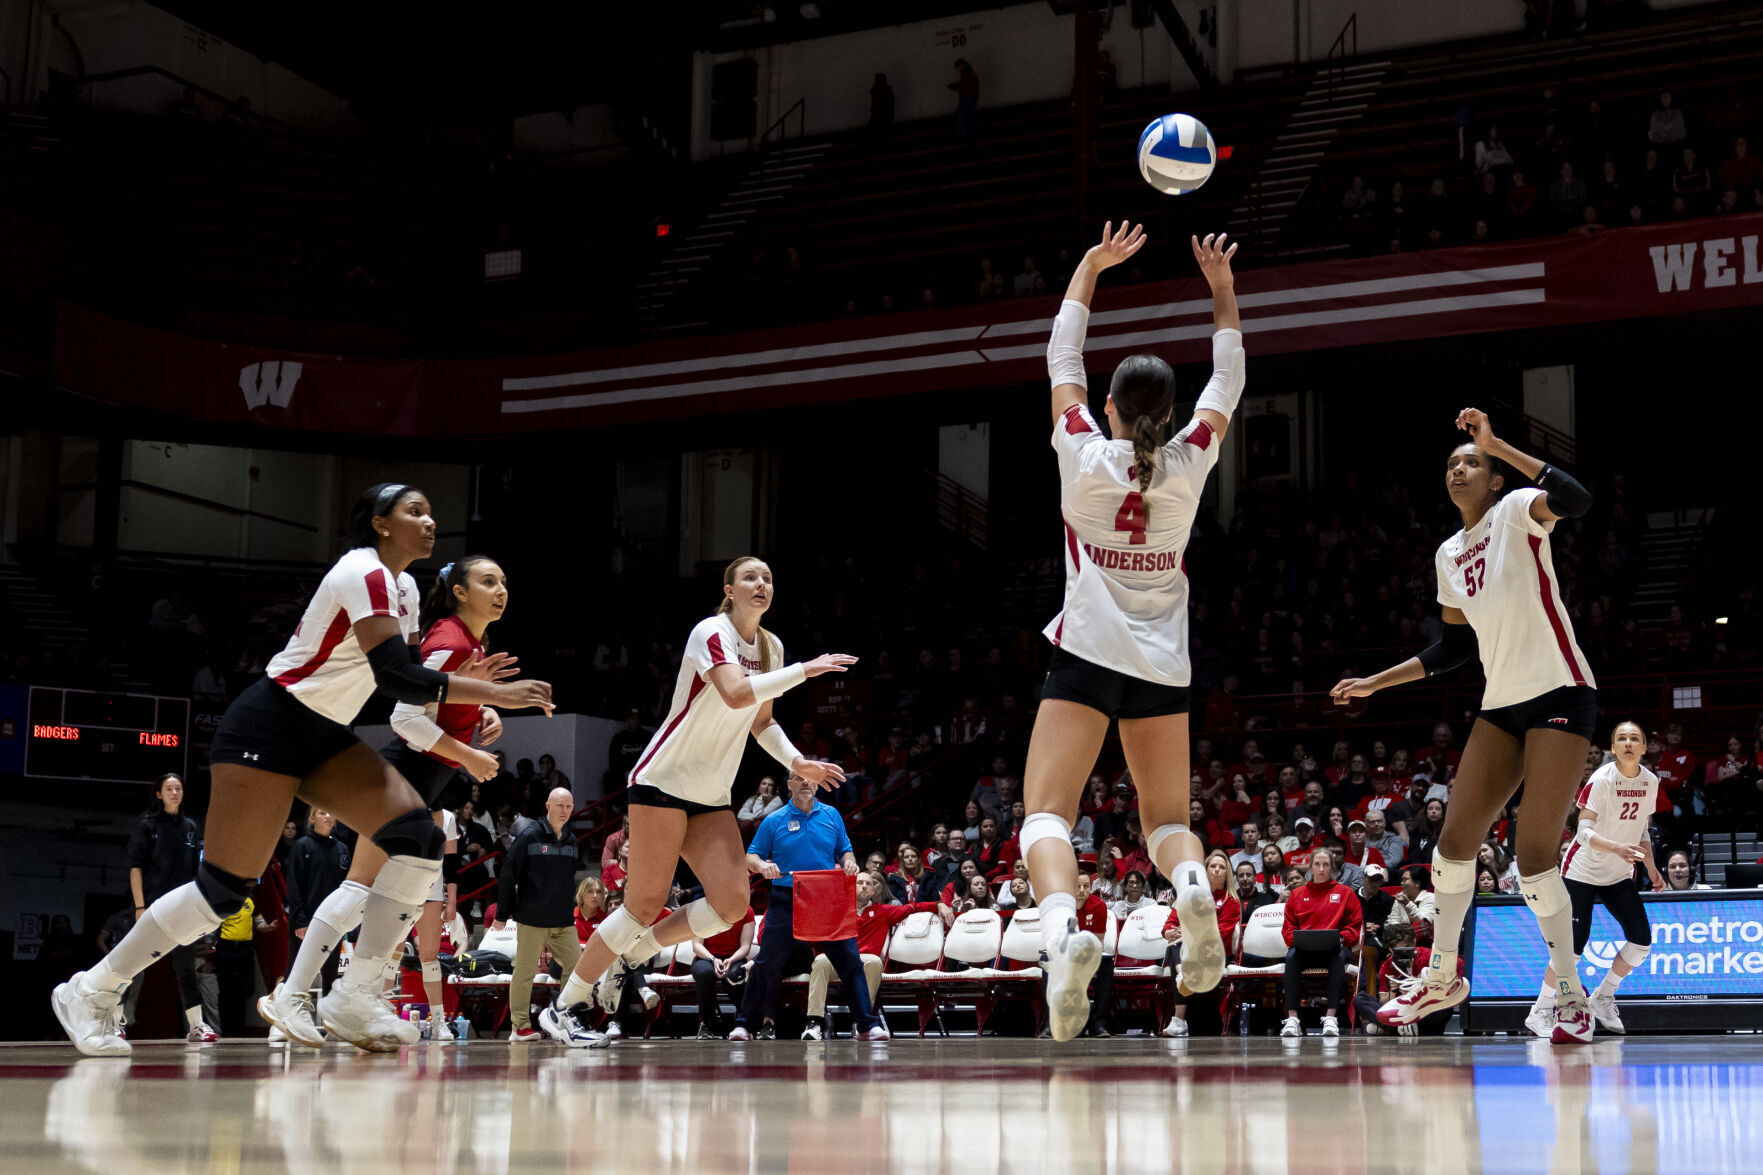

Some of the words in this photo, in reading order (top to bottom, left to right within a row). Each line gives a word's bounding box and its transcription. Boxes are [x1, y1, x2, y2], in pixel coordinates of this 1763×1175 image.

[238, 360, 304, 413] W
[1114, 491, 1146, 545] 4
[33, 724, 80, 741] BADGERS
[139, 731, 179, 748] FLAMES
[1615, 789, 1647, 798] WISCONSIN
[1619, 801, 1640, 821] 22
[1253, 911, 1284, 919] WISCON
[1650, 916, 1763, 944] metro
[1650, 946, 1763, 975] marke
